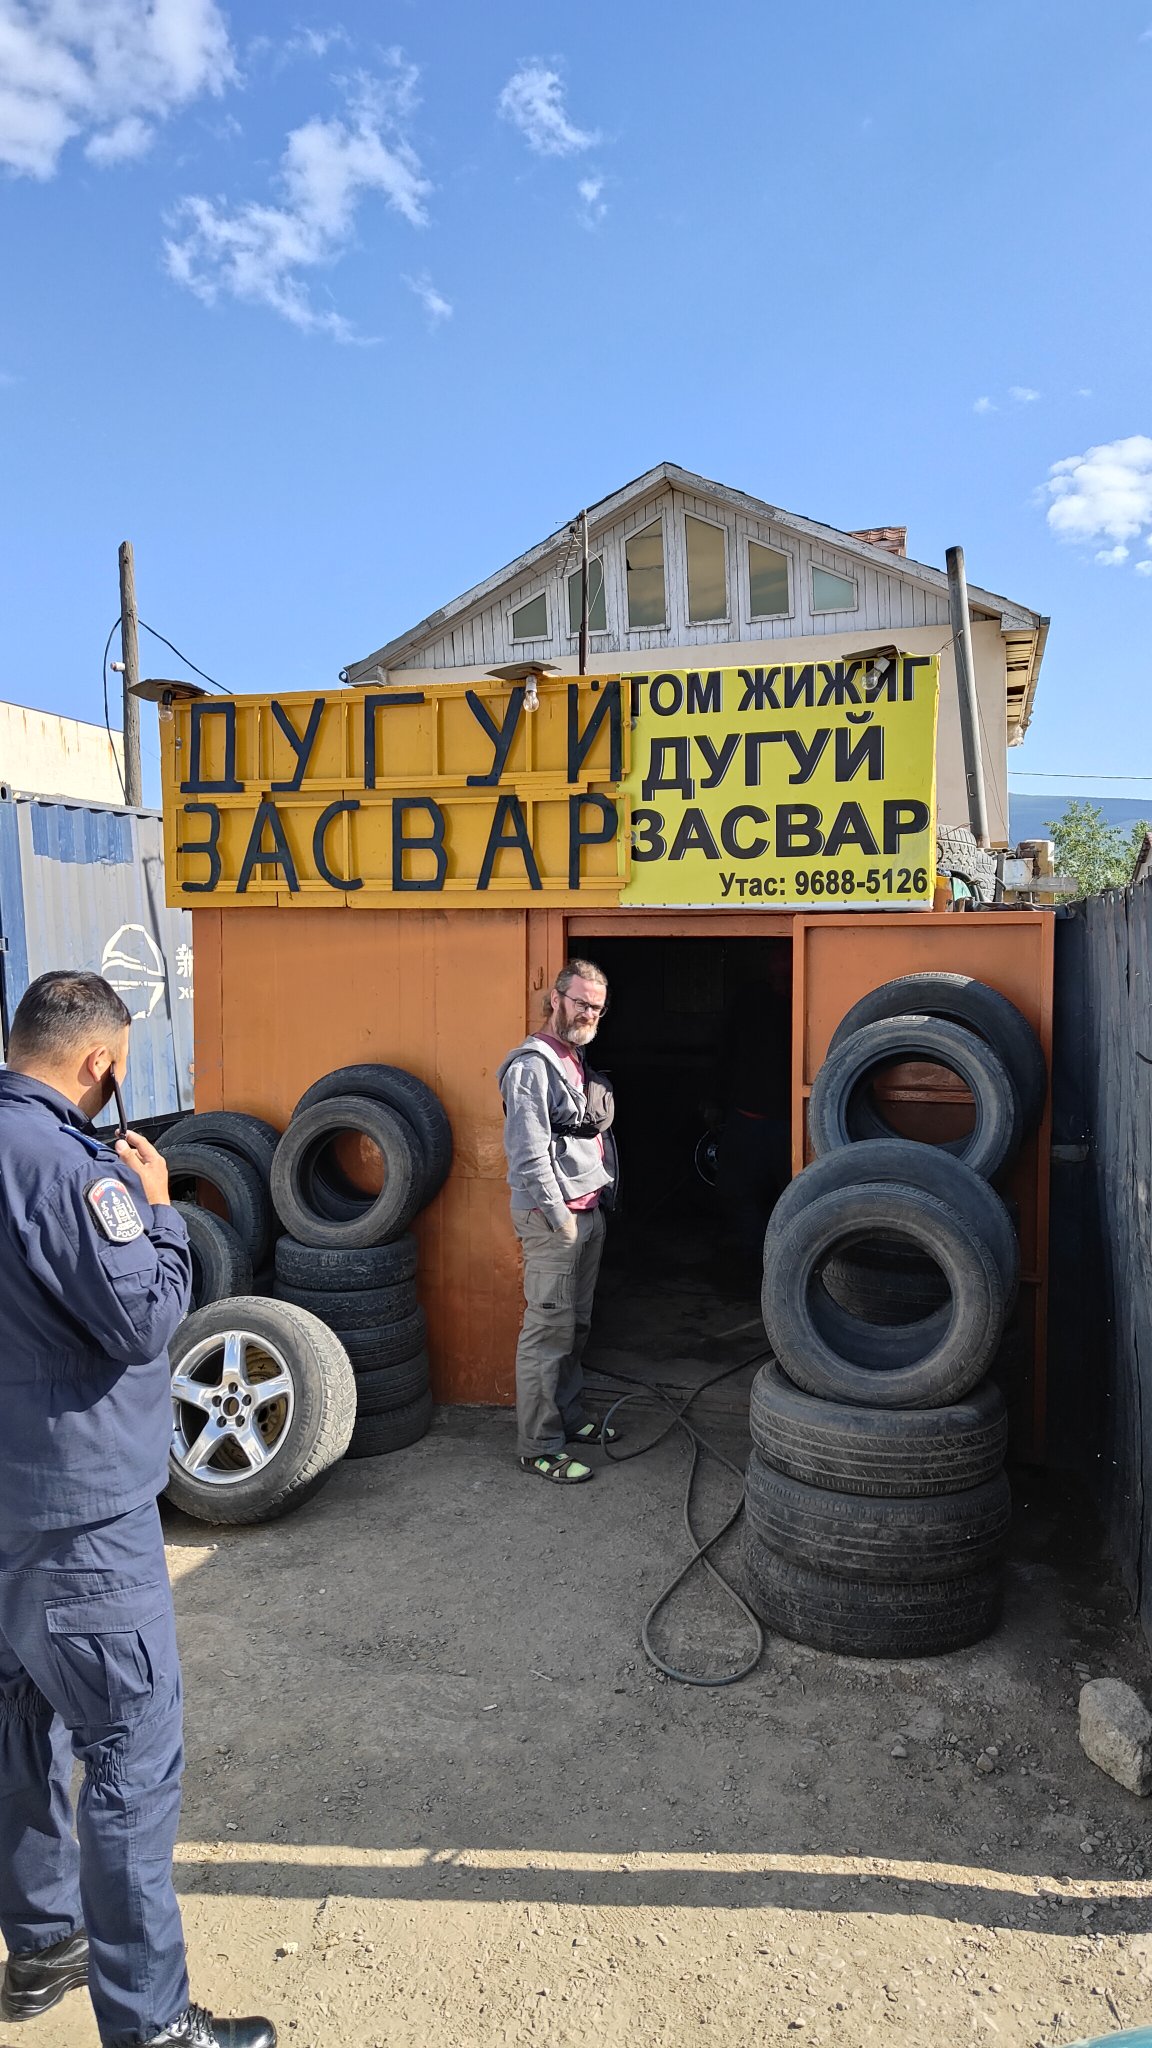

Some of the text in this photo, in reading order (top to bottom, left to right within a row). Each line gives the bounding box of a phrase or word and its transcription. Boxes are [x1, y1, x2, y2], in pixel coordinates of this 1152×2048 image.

[622, 656, 932, 717] ТОМ ЖИЖИГ
[641, 711, 885, 802] ДУГУЙ
[181, 793, 619, 894] ЗАСВАР
[631, 799, 930, 862] ЗАСВАР
[719, 868, 928, 897] Утас: 9688-5126
[116, 1224, 141, 1237] POLICE
